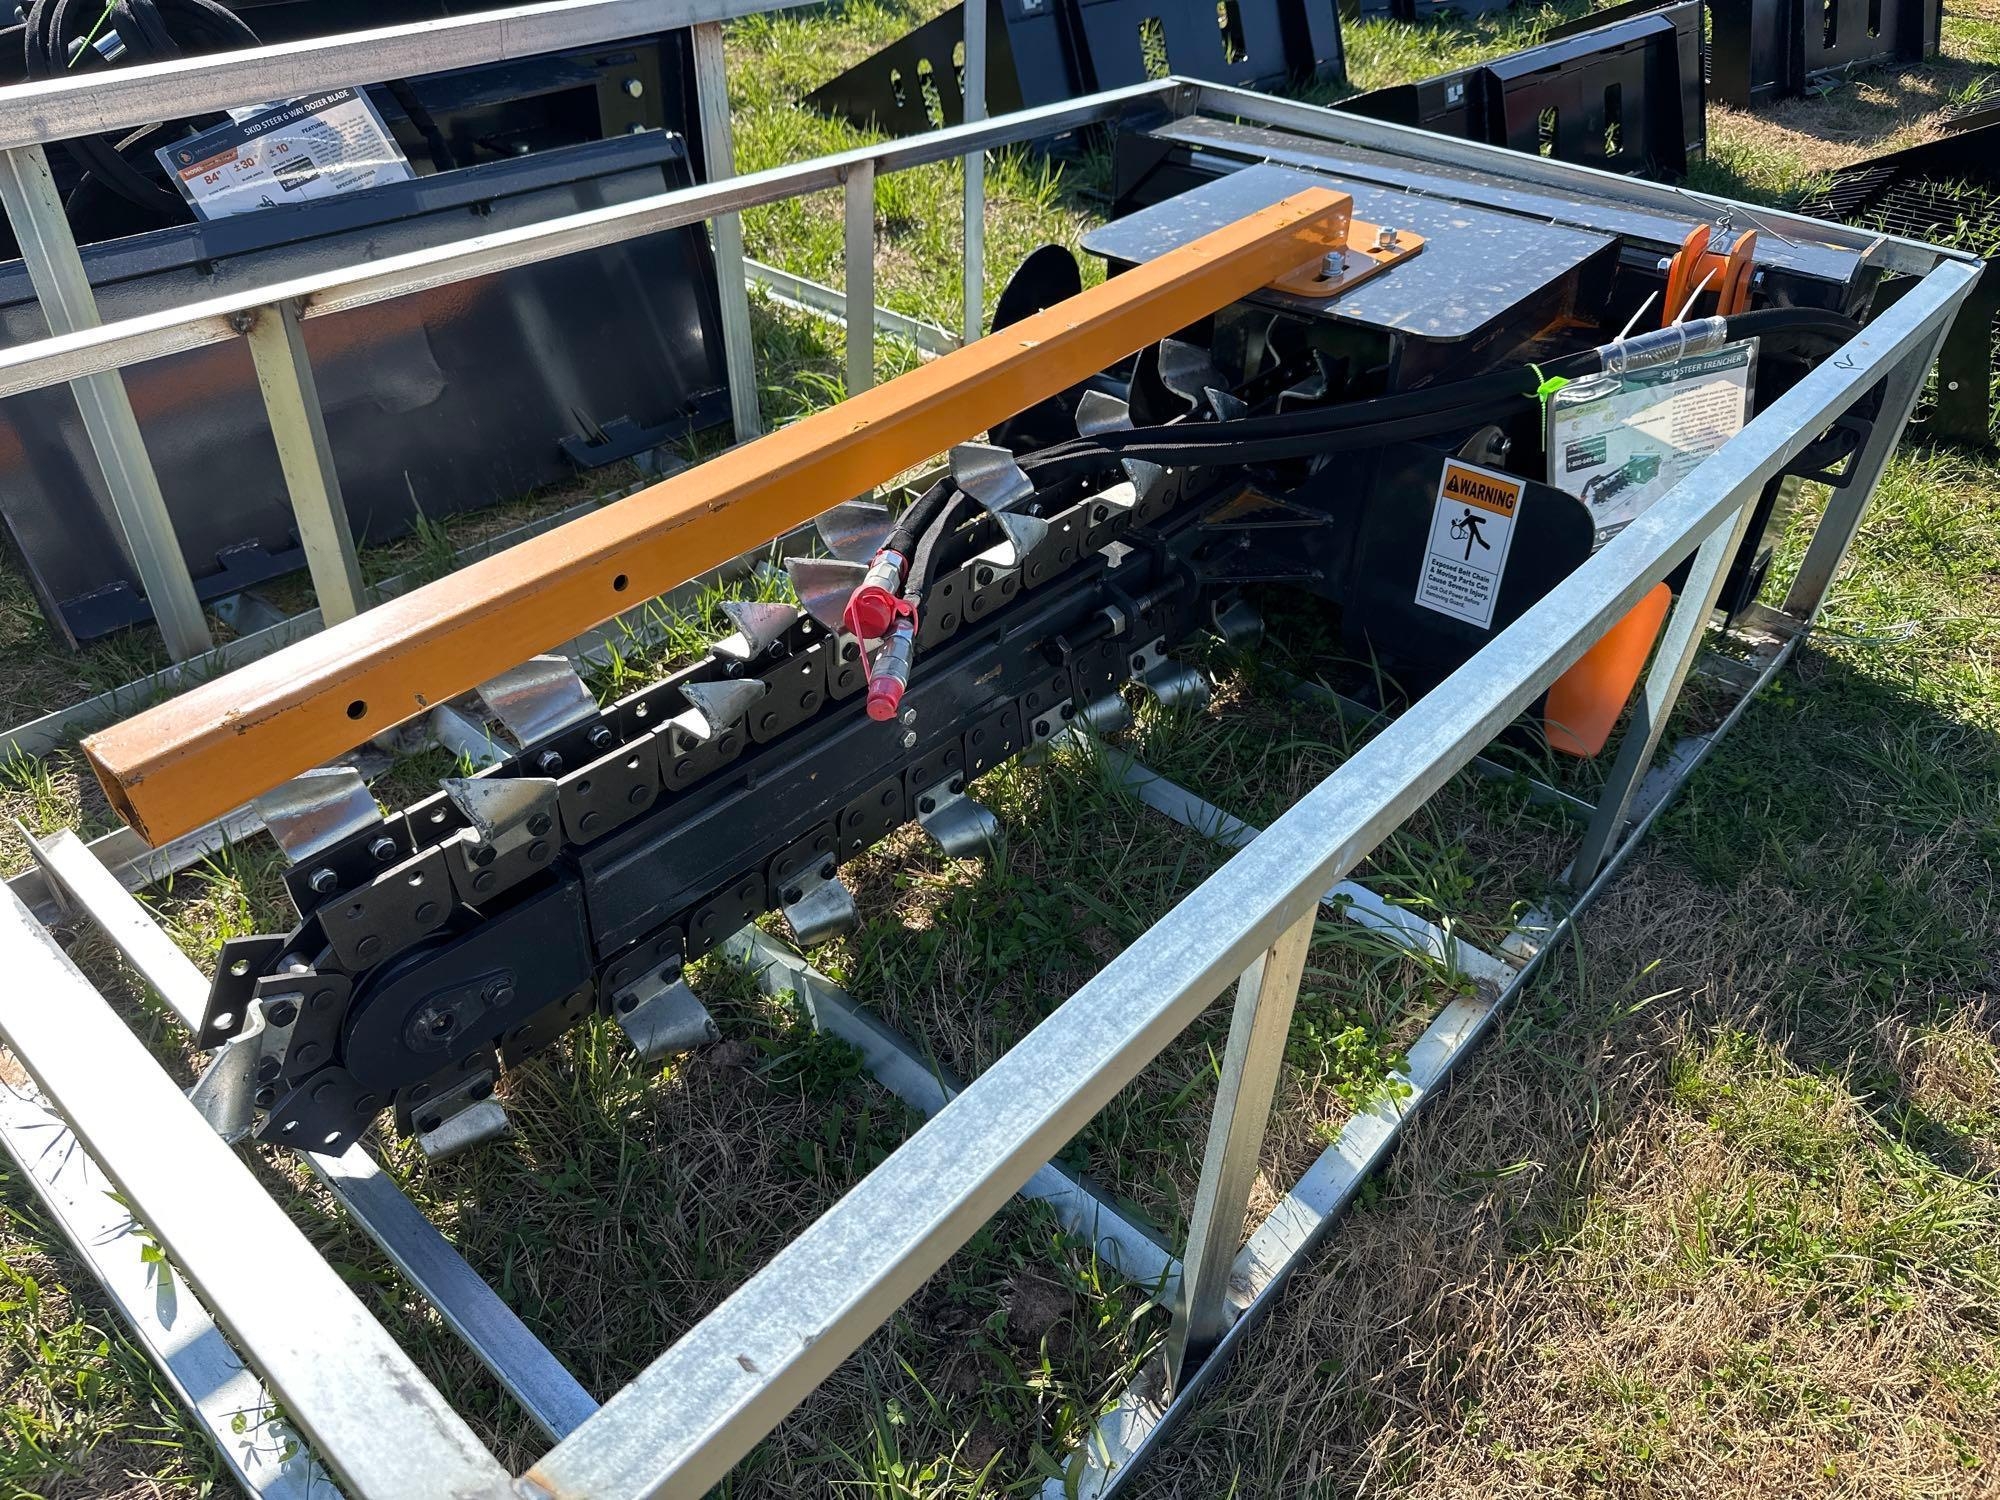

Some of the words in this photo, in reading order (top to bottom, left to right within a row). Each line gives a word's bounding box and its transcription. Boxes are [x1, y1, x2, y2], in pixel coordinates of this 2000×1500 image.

[244, 122, 262, 136] SKID
[261, 114, 284, 130] STEER
[288, 106, 305, 118] WAY
[304, 97, 328, 112] DOZER
[328, 89, 350, 103] BLADE
[301, 120, 328, 134] FEATURES
[1661, 369, 1679, 379] SKID
[1679, 363, 1702, 375] STEER
[1703, 355, 1742, 370] TRENCHER
[1460, 479, 1514, 510] WARNING
[1432, 558, 1458, 573] Exposed
[1472, 572, 1490, 584] Chain
[1436, 568, 1458, 582] Moving
[1458, 576, 1475, 587] Parts
[1476, 582, 1488, 592] Can
[1426, 583, 1438, 591] Lock
[1428, 574, 1447, 585] Cause
[1447, 581, 1469, 593] Severe
